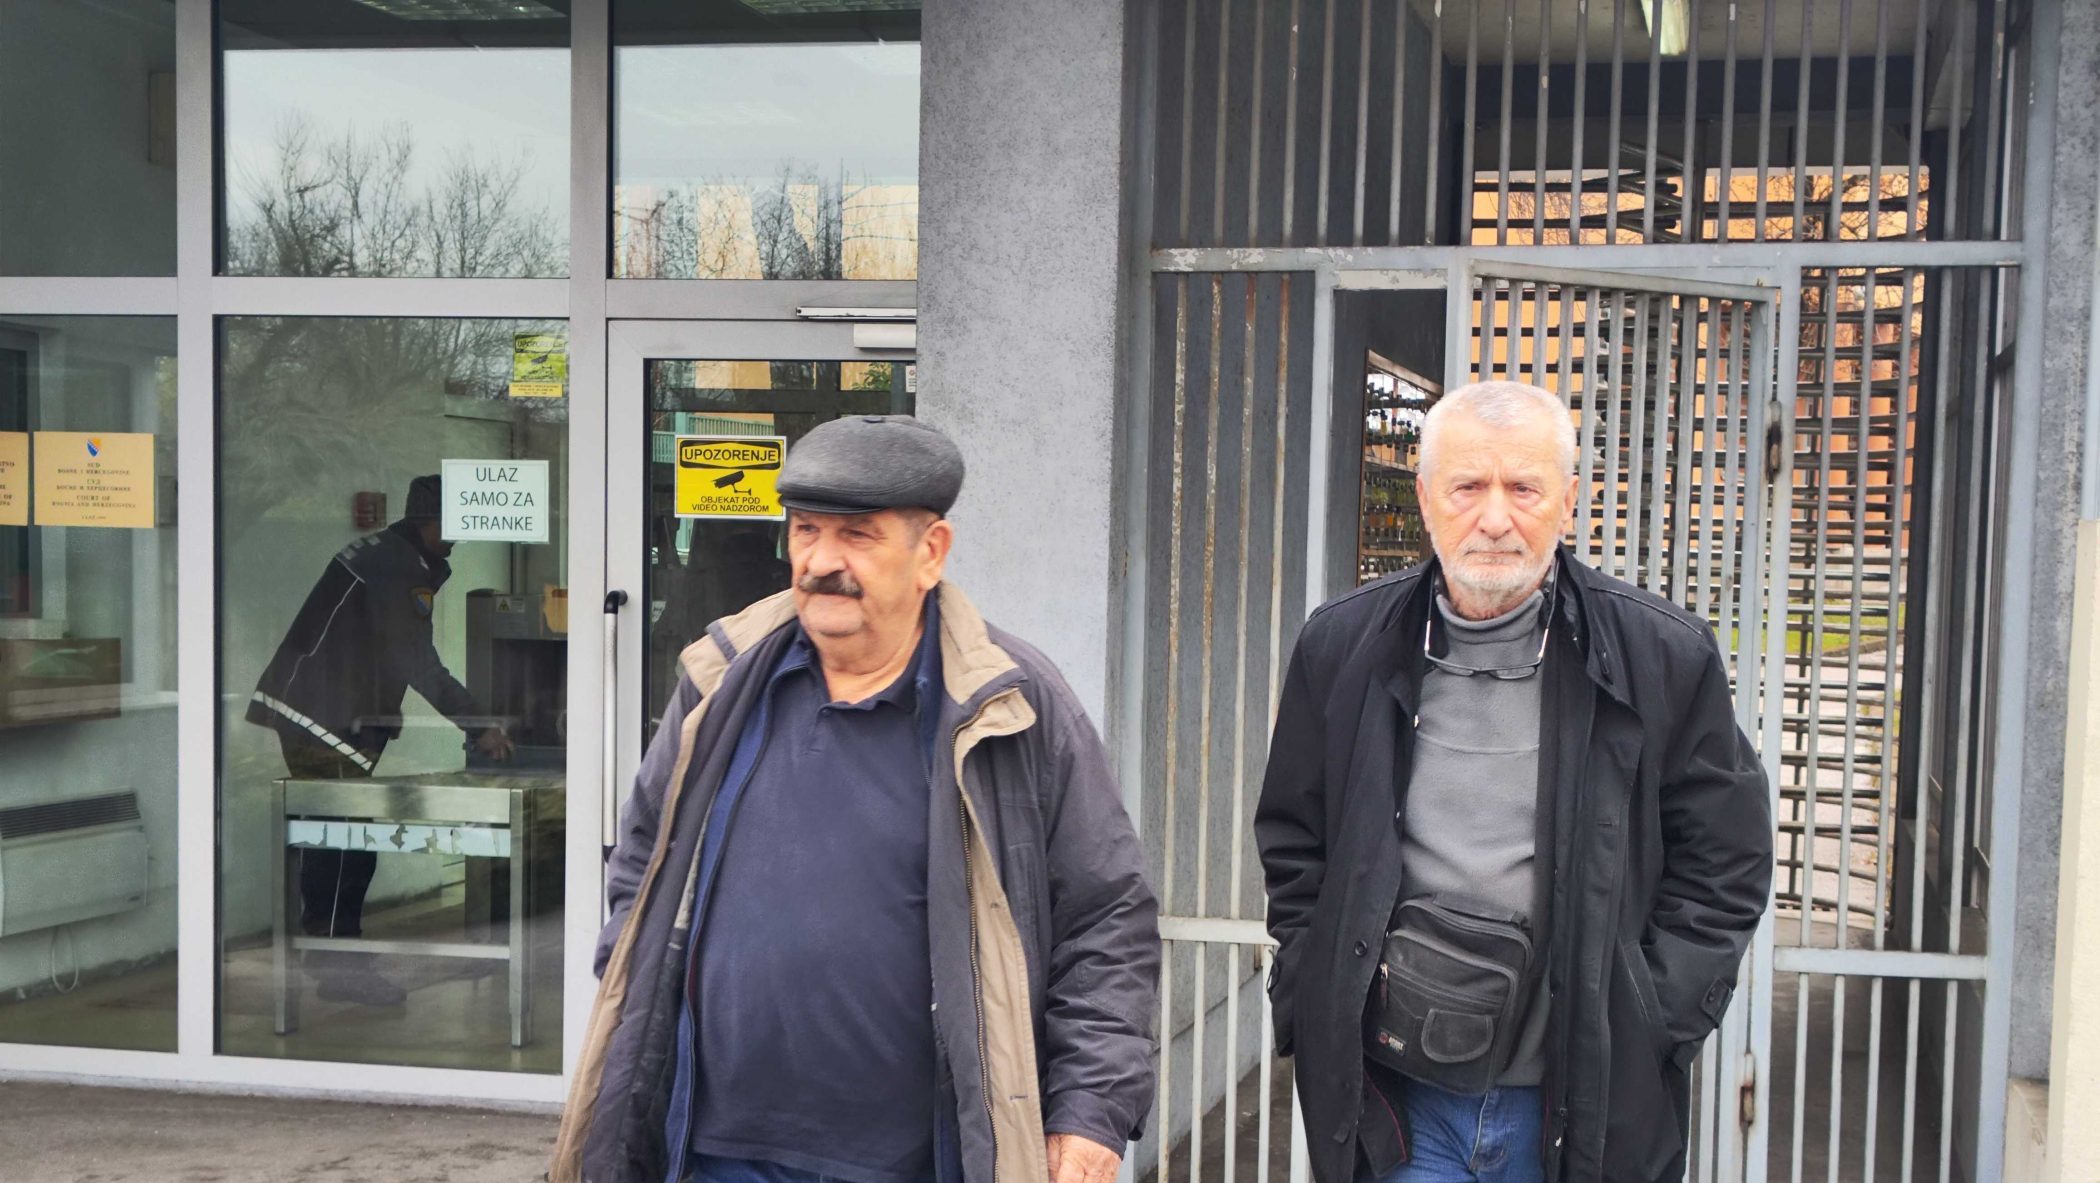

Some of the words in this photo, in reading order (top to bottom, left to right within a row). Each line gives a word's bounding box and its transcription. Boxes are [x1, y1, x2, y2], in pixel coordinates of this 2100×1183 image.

[684, 448, 777, 462] UPOZORENJE
[475, 466, 519, 483] ULAZ
[459, 490, 509, 507] SAMO
[512, 491, 535, 507] ZA
[700, 495, 740, 504] OBJEKAT
[741, 496, 761, 505] POD
[691, 503, 718, 512] VIDEO
[719, 504, 770, 513] NADZOROM
[460, 515, 534, 532] STRANKE
